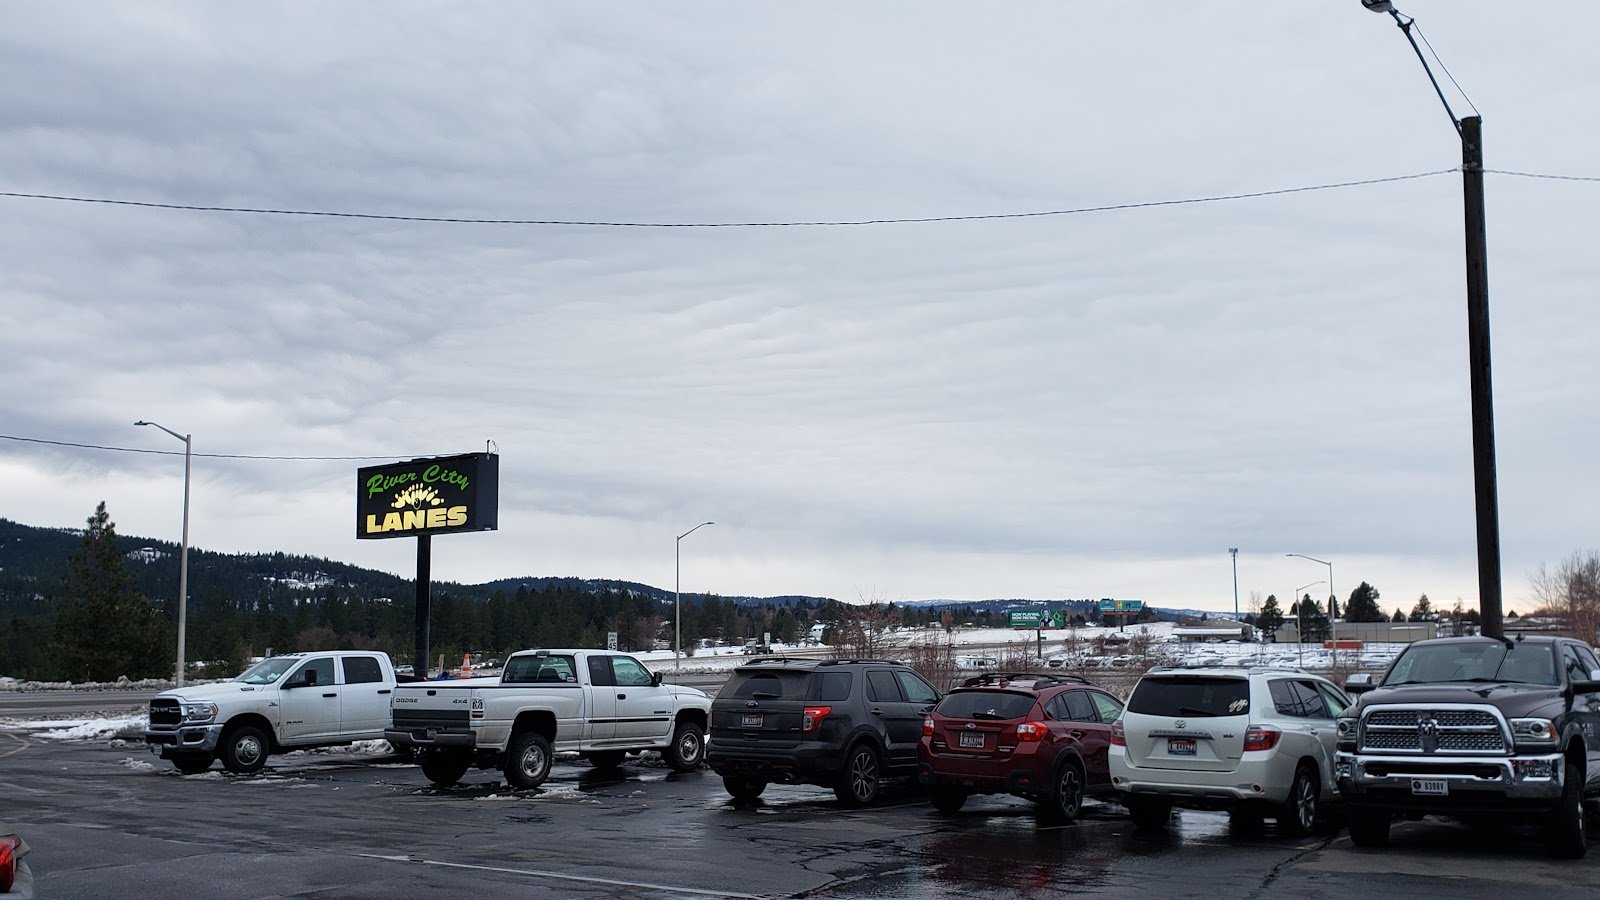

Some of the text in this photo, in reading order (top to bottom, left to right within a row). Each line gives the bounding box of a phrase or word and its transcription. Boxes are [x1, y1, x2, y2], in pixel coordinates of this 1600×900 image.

[366, 464, 470, 500] River City
[366, 505, 468, 534] LANES
[608, 642, 617, 650] 45
